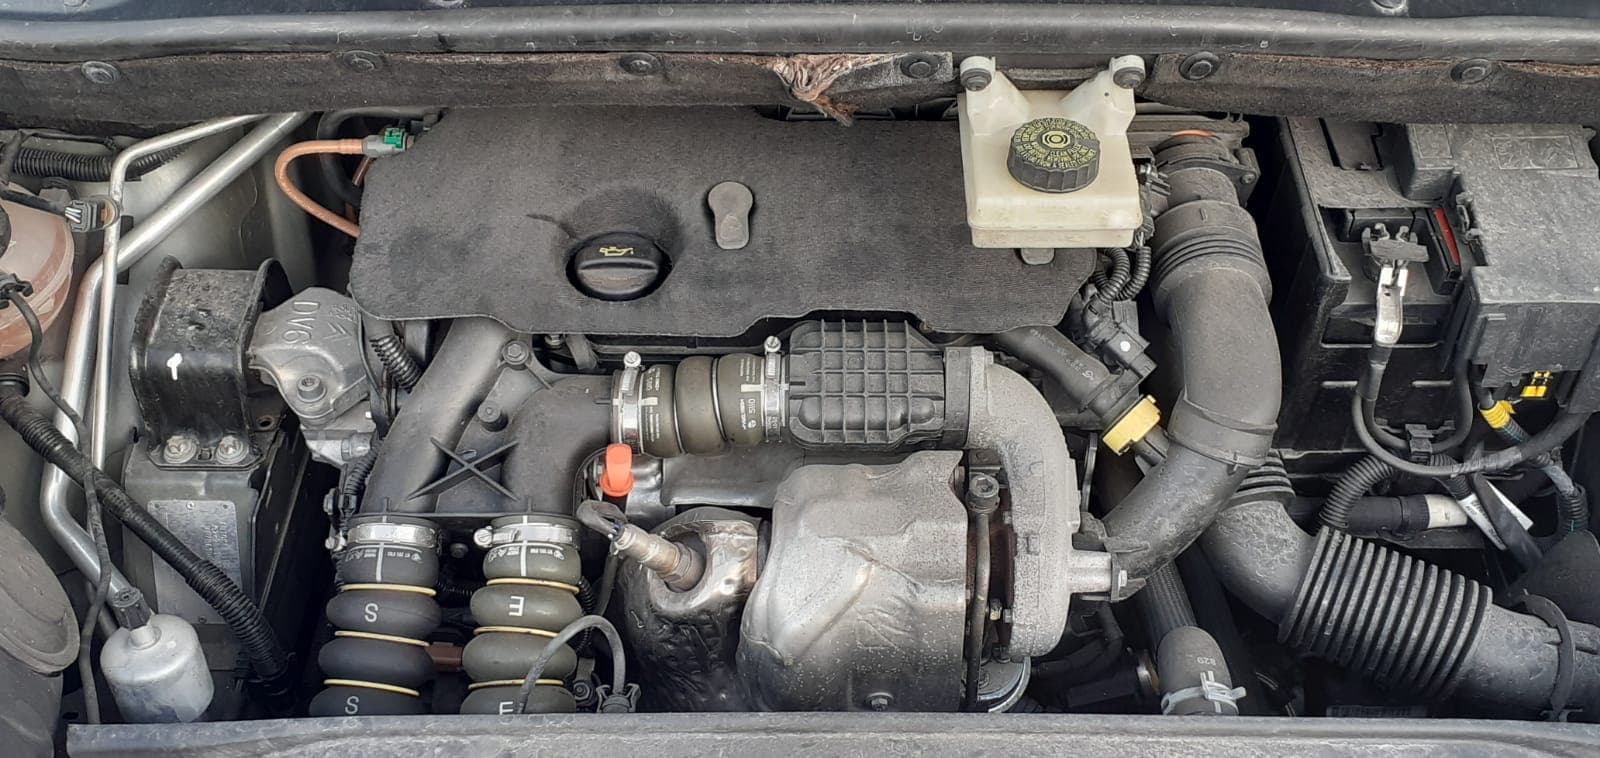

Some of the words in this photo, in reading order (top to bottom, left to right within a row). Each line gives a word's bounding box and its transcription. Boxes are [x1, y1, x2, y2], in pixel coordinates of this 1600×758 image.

[282, 300, 320, 345] DV6
[364, 603, 379, 622] S
[344, 696, 359, 715] S
